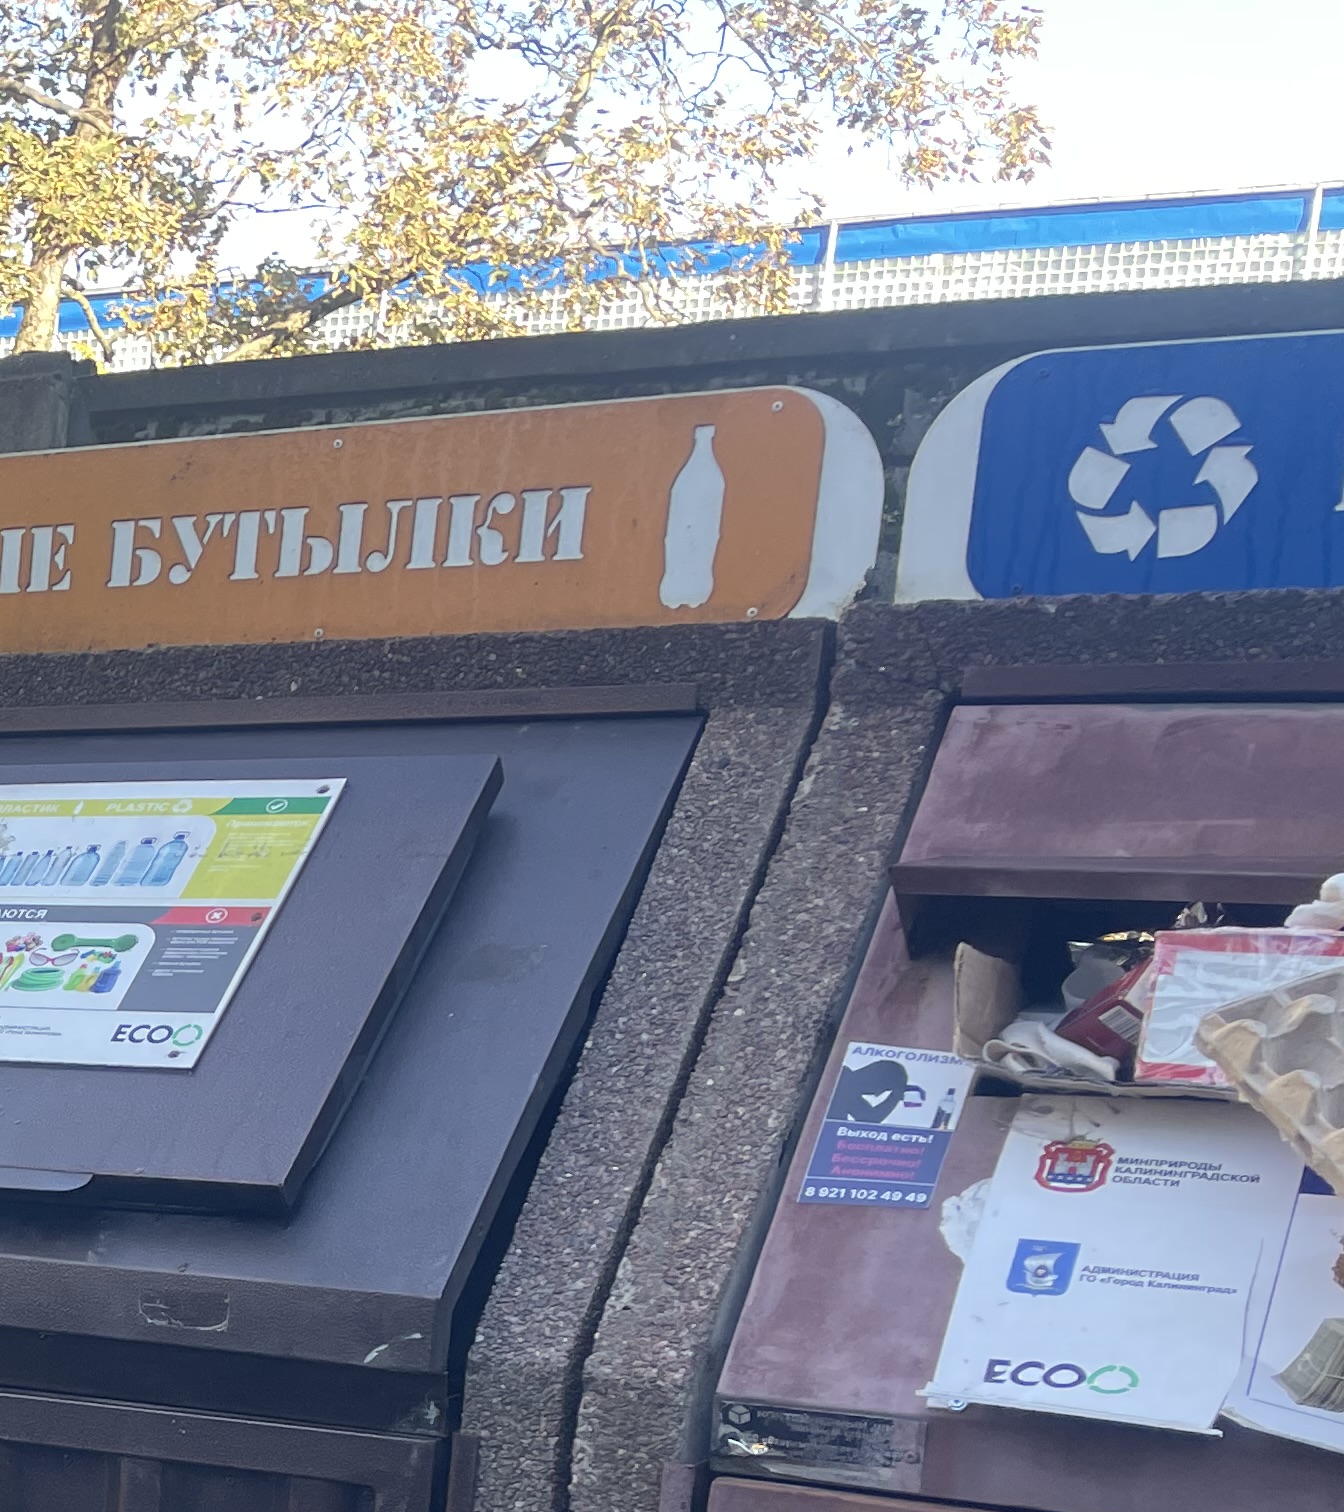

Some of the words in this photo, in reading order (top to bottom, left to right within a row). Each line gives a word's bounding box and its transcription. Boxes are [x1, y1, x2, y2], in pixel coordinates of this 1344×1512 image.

[107, 484, 592, 590] БУТЫЛКИ
[106, 802, 170, 813] PLASTIC
[836, 1126, 888, 1141] Выход
[891, 1133, 934, 1144] есть!
[1116, 1156, 1223, 1172] МИНПРИРОДЫ
[1111, 1175, 1180, 1188] ОБЛАСТИ
[1114, 1166, 1261, 1184] КАЛИНИНГРАДСКОЙ
[805, 1187, 815, 1196] 8
[818, 1187, 846, 1198] 921
[850, 1189, 878, 1200] 102
[880, 1191, 903, 1201] 49
[905, 1192, 927, 1203] 49
[1079, 1274, 1097, 1284] ГО
[1081, 1264, 1200, 1282] АДМИНИСТРАЦИЯ
